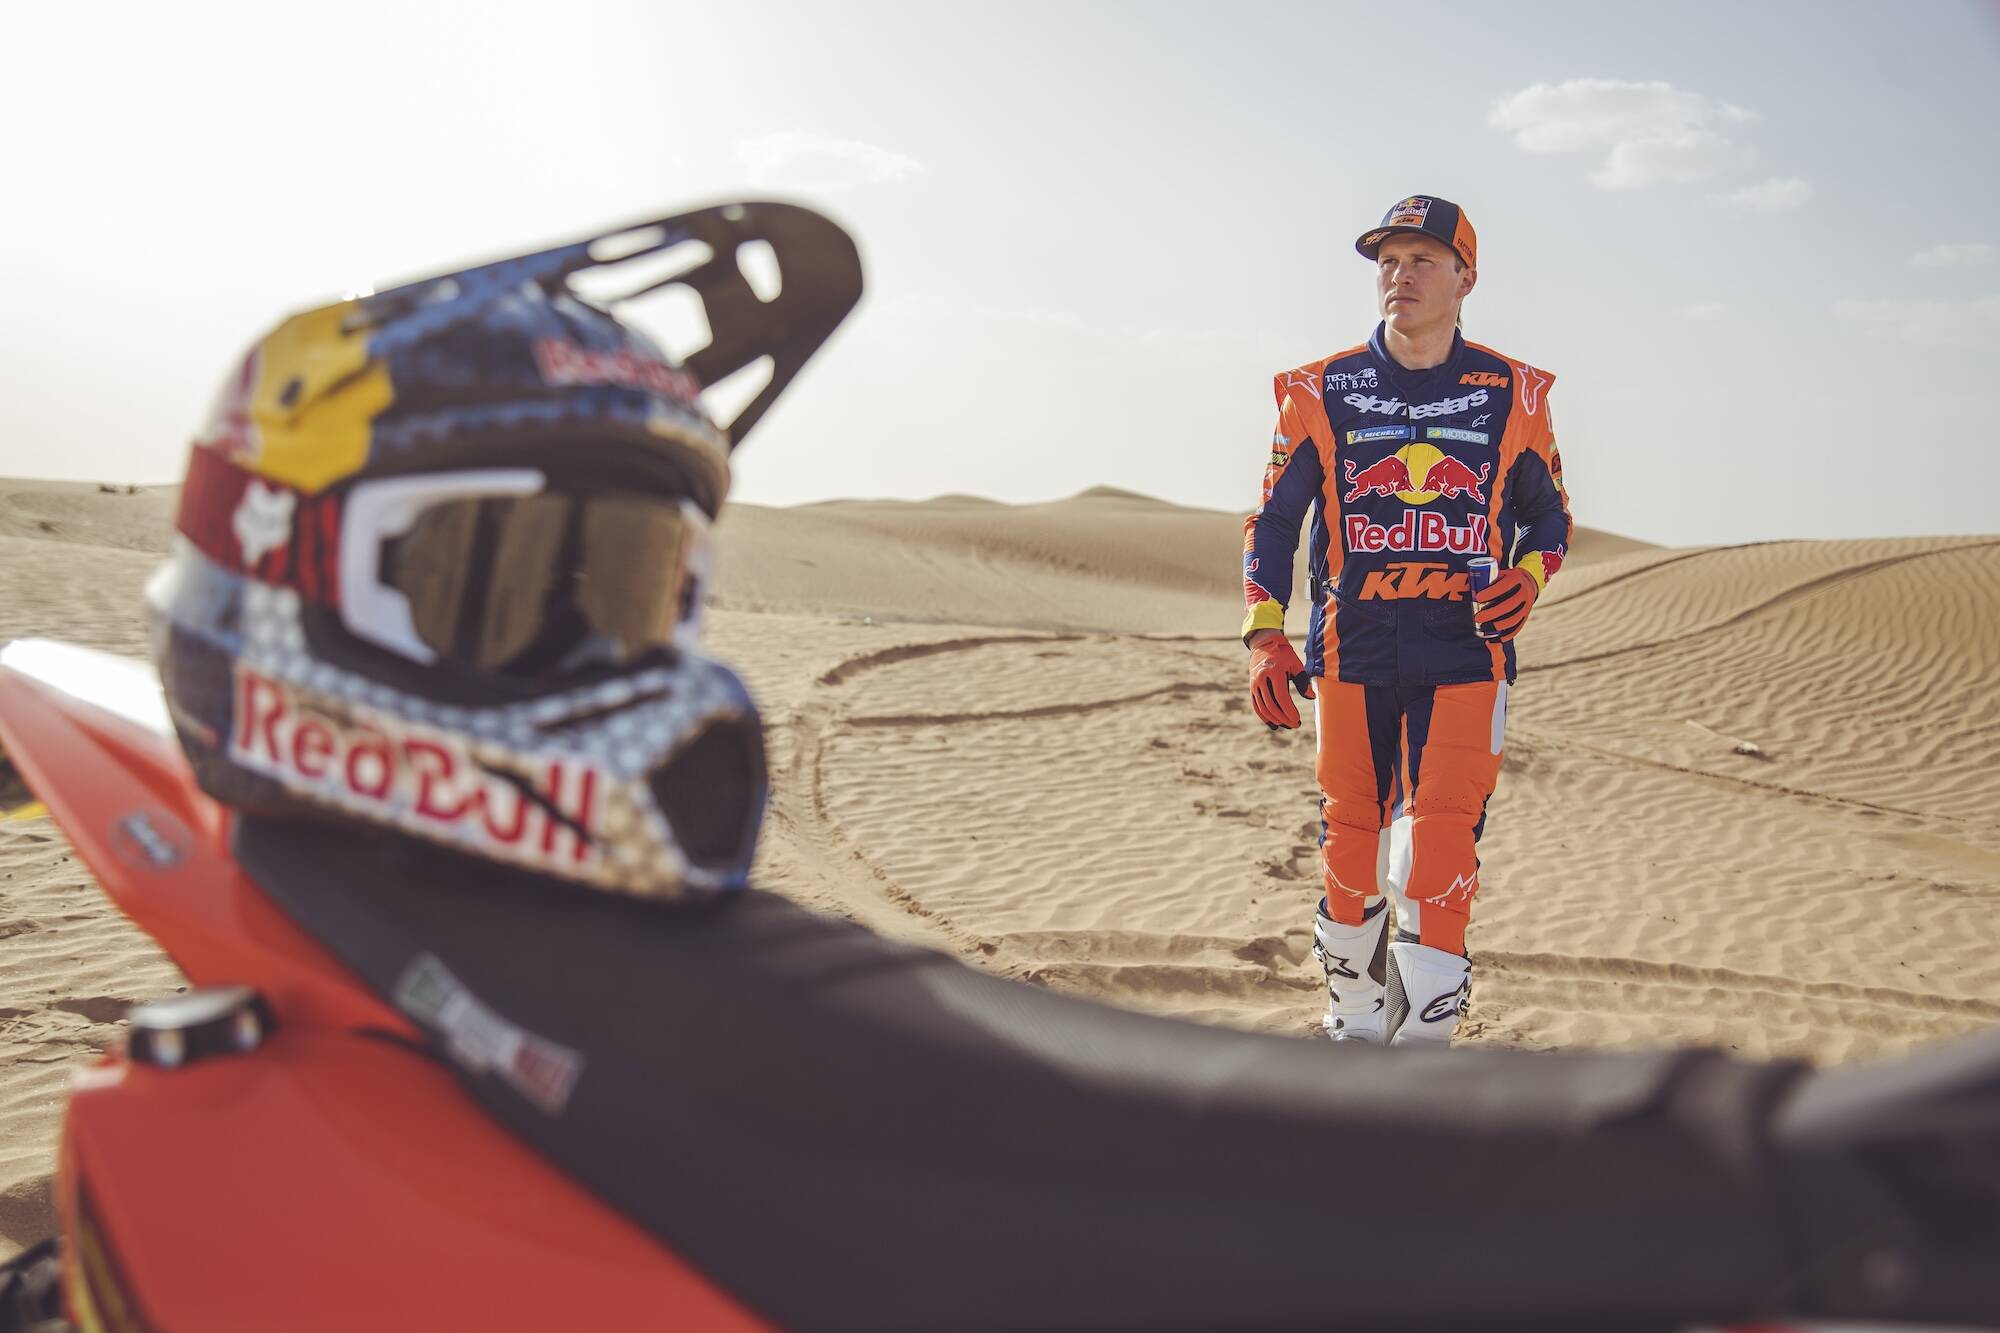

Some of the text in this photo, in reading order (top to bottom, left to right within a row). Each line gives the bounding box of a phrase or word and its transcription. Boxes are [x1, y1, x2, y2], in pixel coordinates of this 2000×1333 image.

[1326, 378, 1378, 392] AIR BAG
[1459, 371, 1509, 388] KTM
[1343, 389, 1489, 420] alpinestars
[1364, 430, 1405, 438] MICHELIN
[1442, 429, 1488, 444] MOTOREX
[1346, 509, 1487, 554] Red Bull
[1359, 562, 1471, 600] KTM
[238, 669, 601, 863] Red Bull
